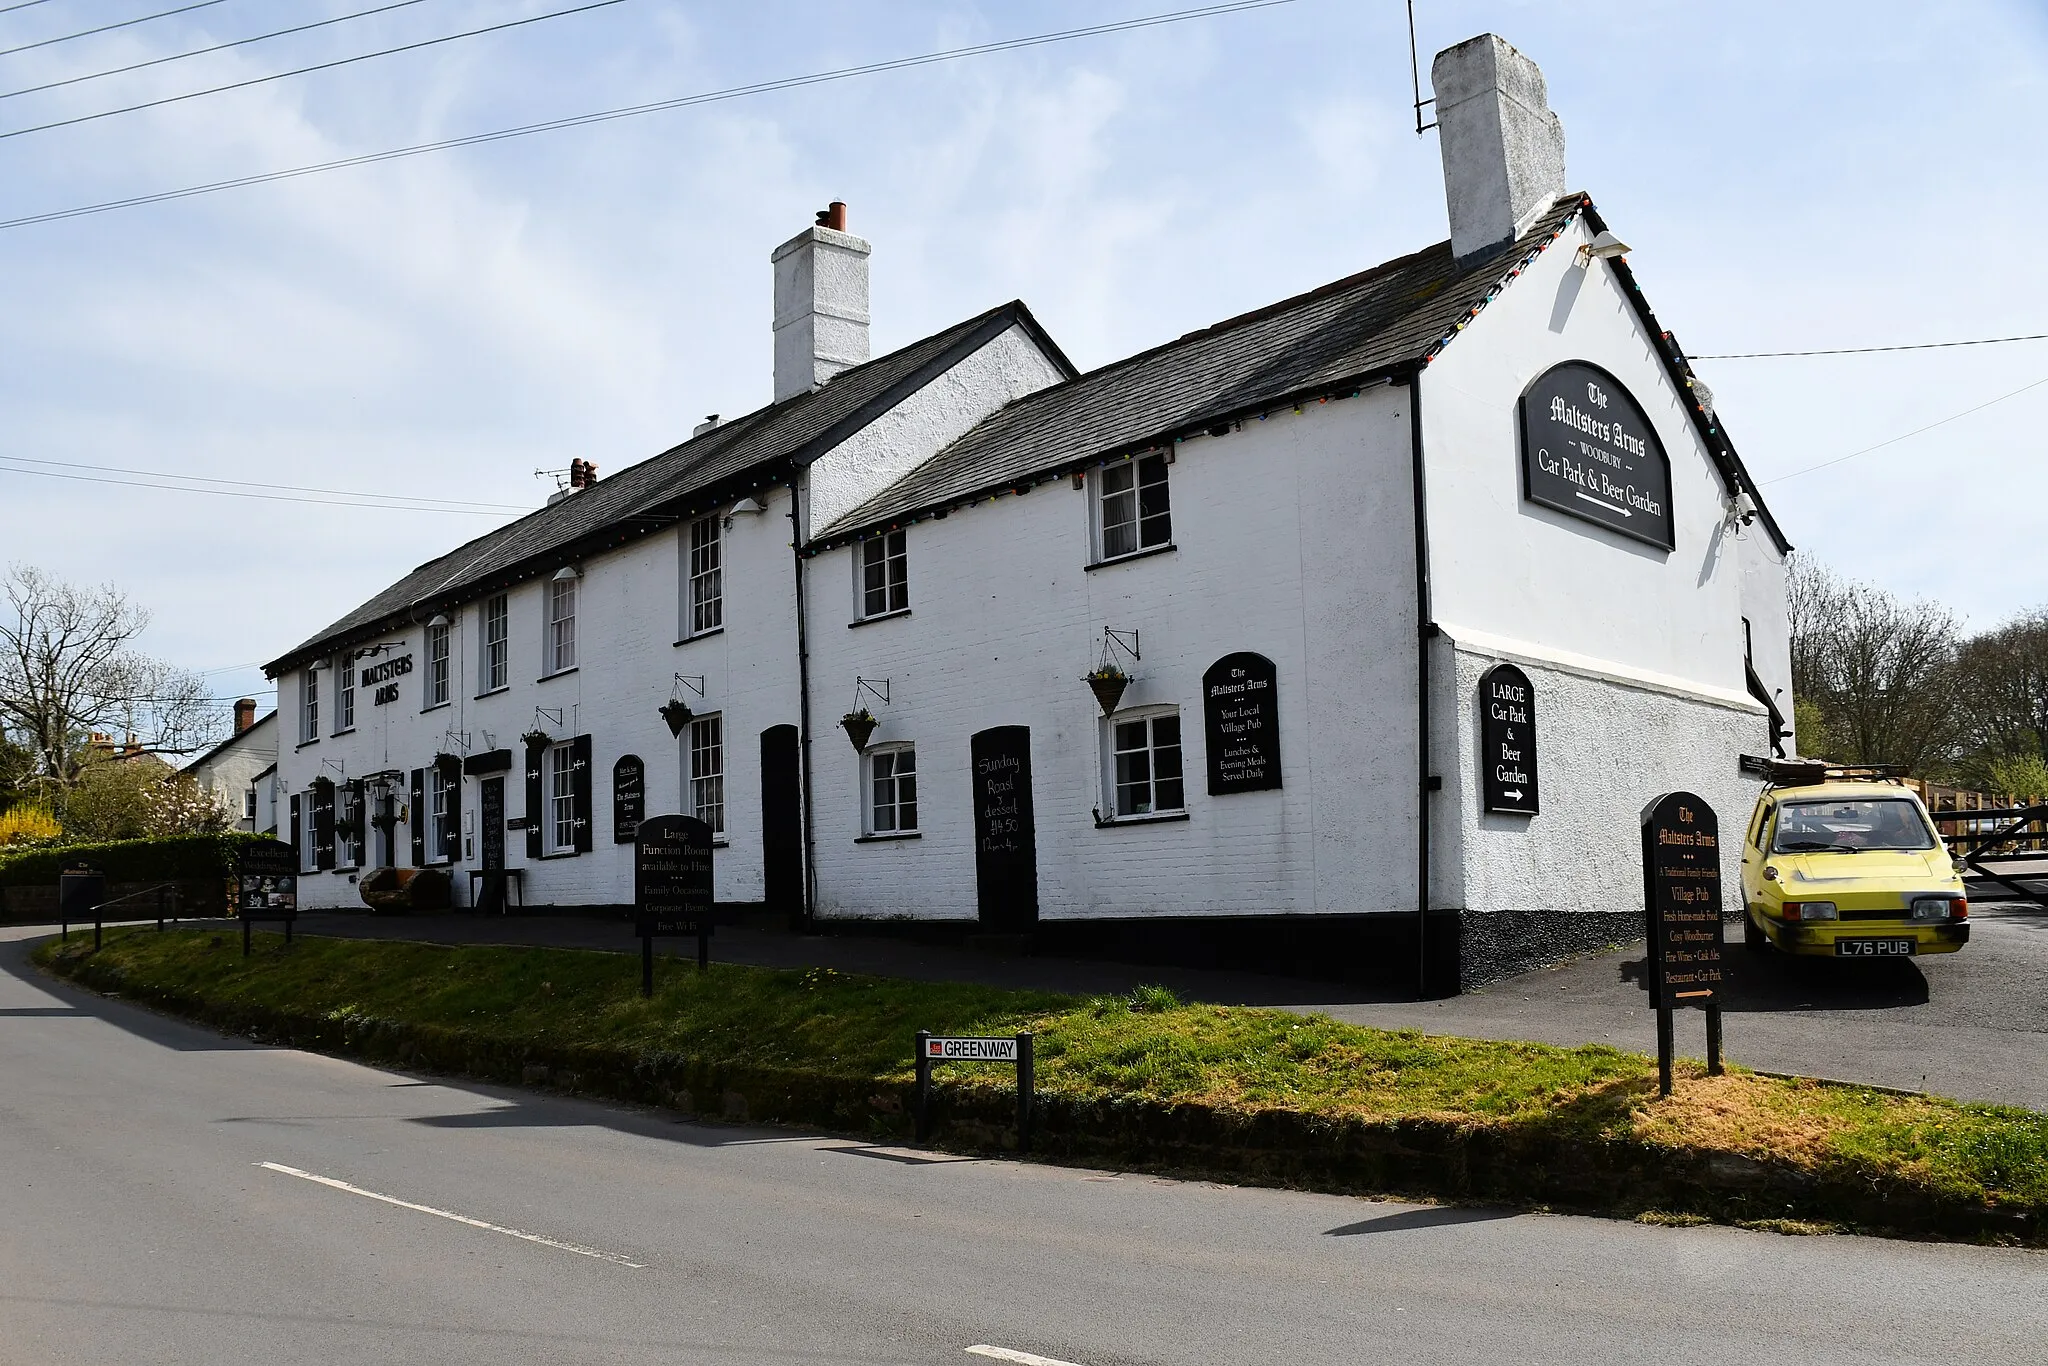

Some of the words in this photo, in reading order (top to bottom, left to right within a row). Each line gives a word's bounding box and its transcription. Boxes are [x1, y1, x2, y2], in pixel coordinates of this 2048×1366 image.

[1587, 382, 1608, 409] The
[1551, 395, 1610, 442] Maltsters
[1613, 422, 1646, 458] Arms
[1580, 441, 1621, 470] WOODBURY
[1538, 449, 1559, 476] Car
[1562, 457, 1586, 487] Park
[1587, 469, 1600, 492] &
[1601, 474, 1624, 501] Beer
[1626, 485, 1661, 517] Garden
[362, 653, 412, 687] MALTSTERS
[1231, 669, 1245, 677] The
[374, 682, 398, 706] ARMS
[1211, 685, 1244, 697] Maltsters
[1247, 679, 1267, 690] Arms
[1493, 683, 1524, 702] LARGE
[1221, 709, 1237, 719] Your
[1240, 704, 1259, 716] Local
[1491, 703, 1507, 720] Car
[1509, 706, 1526, 724] Park
[1221, 723, 1245, 733] Village
[1247, 719, 1261, 729] Pub
[1507, 728, 1514, 740] &
[1225, 747, 1250, 757] Lunches
[1252, 745, 1259, 753] &
[1502, 743, 1521, 762] Beer
[979, 754, 1019, 774] Sunday
[1220, 760, 1245, 771] Evening
[1247, 756, 1266, 766] Meals
[1222, 770, 1244, 781] Served
[1247, 768, 1264, 779] Daily
[1497, 765, 1527, 784] Garden
[988, 774, 1013, 795] Roast
[985, 797, 1020, 817] dessert
[1679, 807, 1693, 824] The
[664, 829, 688, 842] Large
[1659, 829, 1694, 846] Maltsters
[1696, 830, 1715, 847] Arms
[250, 848, 288, 858] Excellent
[643, 844, 680, 855] Function
[684, 845, 709, 855] Room
[642, 861, 678, 871] available
[681, 863, 689, 871] to
[692, 861, 710, 871] Hire
[645, 886, 669, 896] Family
[1672, 887, 1694, 904] Village
[1696, 887, 1709, 901] Pub
[646, 903, 682, 914] Corporate
[1664, 910, 1677, 922] Fresh
[1706, 909, 1718, 921] Food
[1670, 930, 1683, 945] Cosy
[1684, 929, 1714, 943] Woodburner
[1666, 951, 1676, 963] Fine
[1677, 951, 1693, 962] Wines
[1710, 948, 1720, 961] Ales
[1842, 942, 1872, 955] L76
[1877, 942, 1909, 954] PUB
[1666, 971, 1694, 984] Restaurant
[1698, 969, 1707, 982] Car
[1709, 968, 1722, 981] Park
[945, 1041, 1014, 1057] GREENWAY
